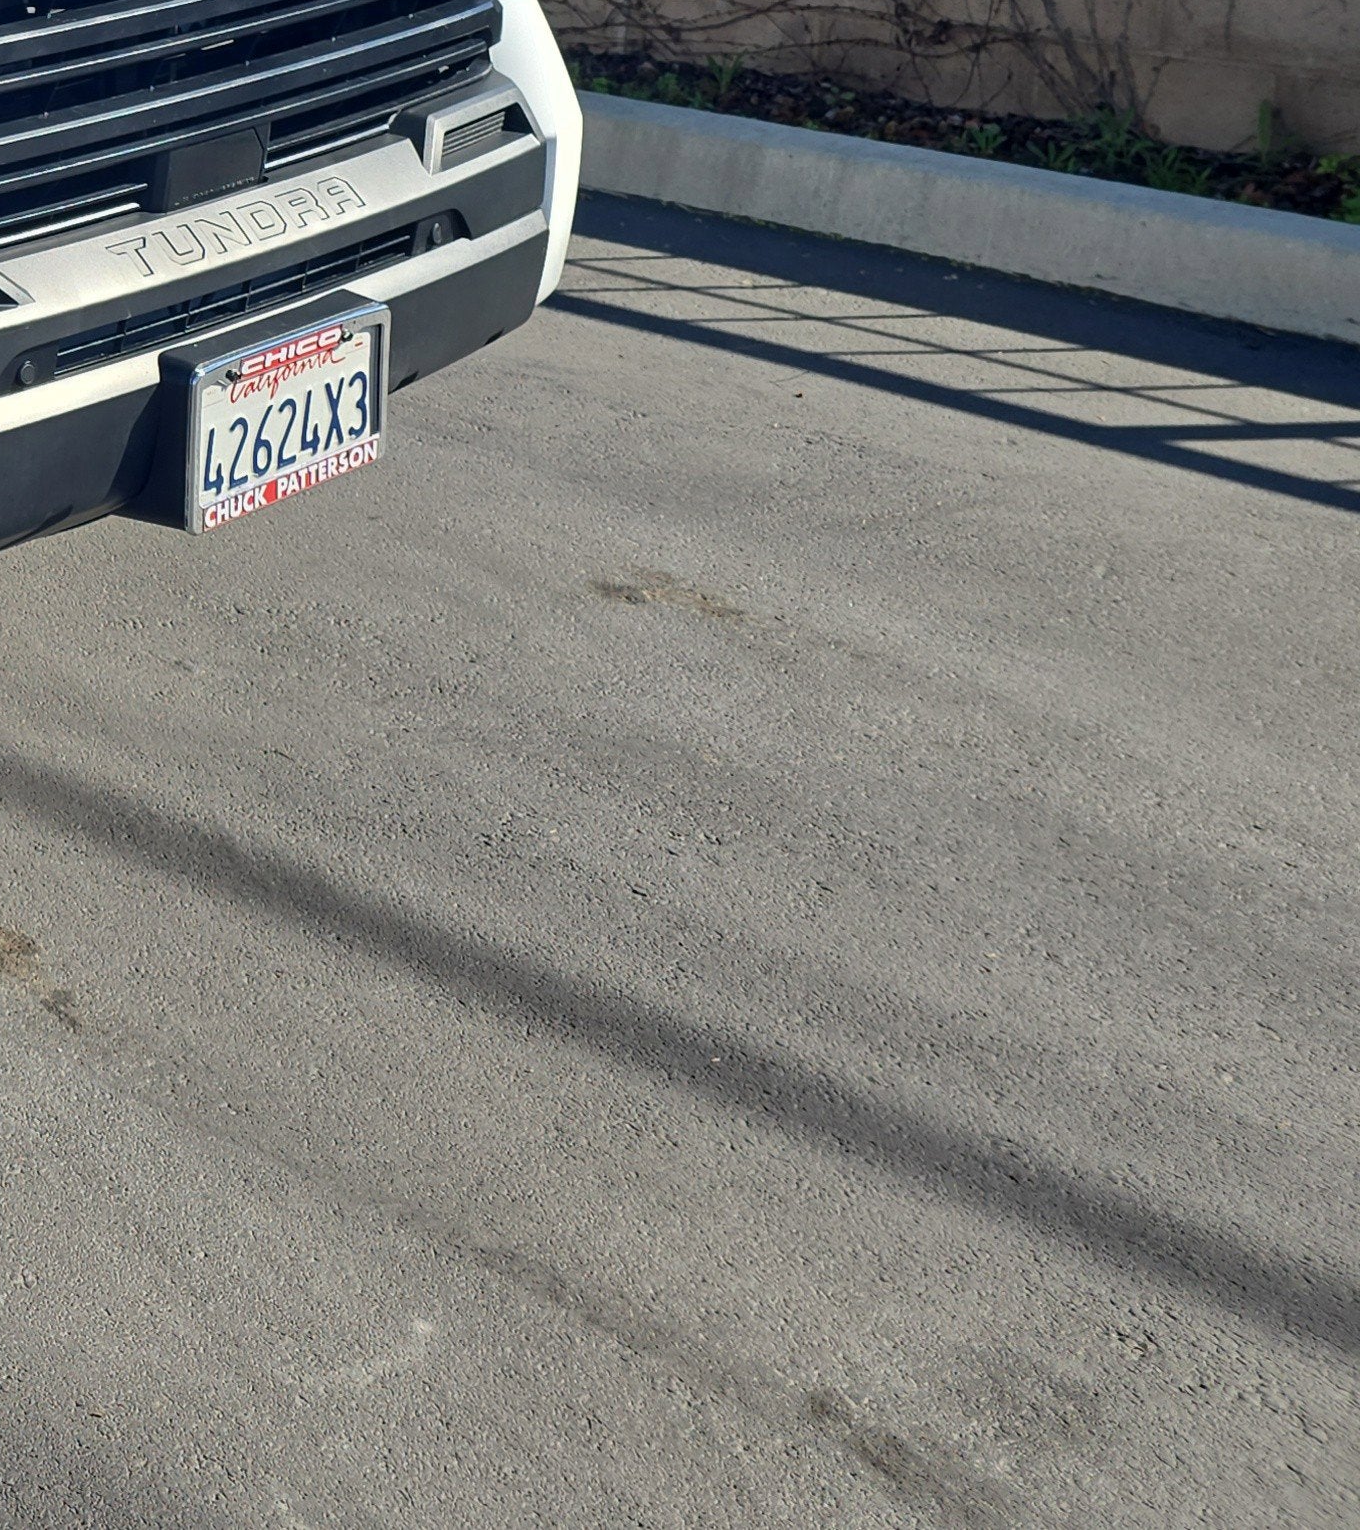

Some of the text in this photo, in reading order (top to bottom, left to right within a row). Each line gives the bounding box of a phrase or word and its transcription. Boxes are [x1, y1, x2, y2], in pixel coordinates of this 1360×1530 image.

[105, 176, 366, 278] TUNDRA
[241, 327, 342, 375] CHICO
[203, 370, 368, 497] 42624X3
[204, 440, 378, 529] CHUCK PATTERSON
